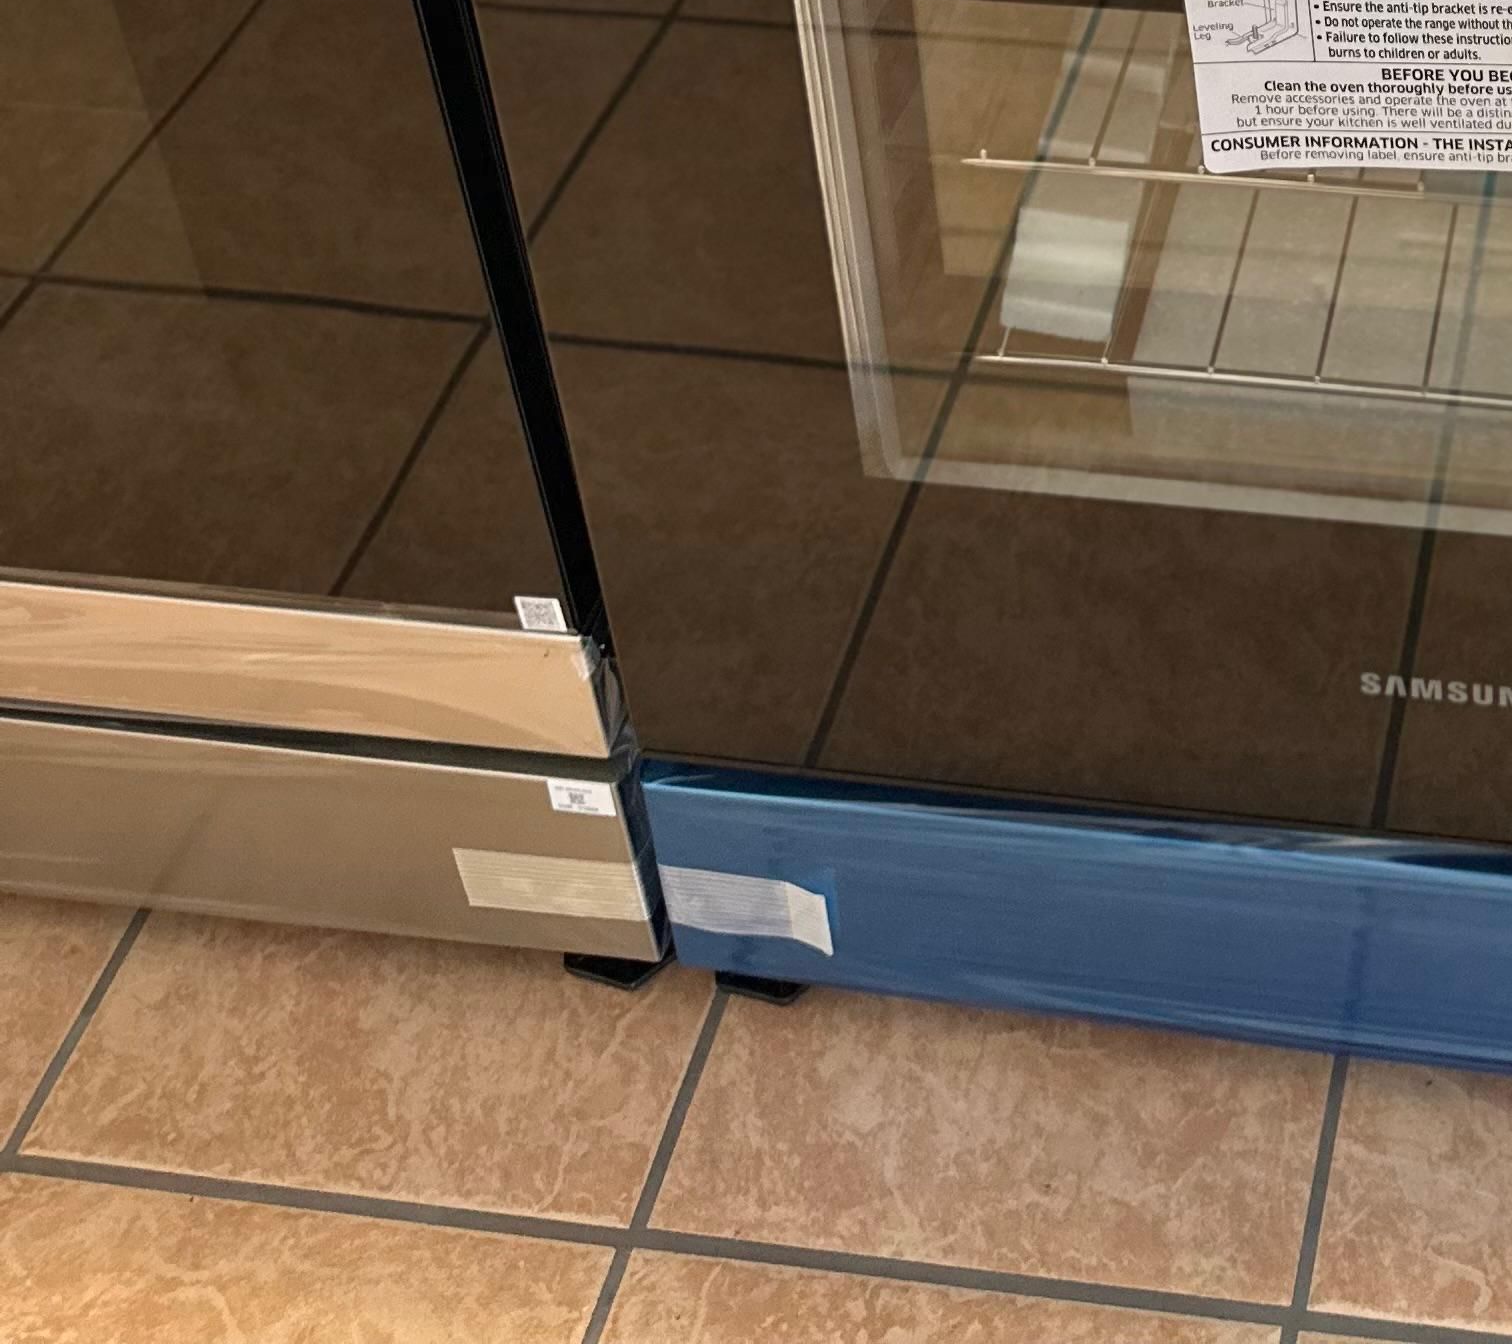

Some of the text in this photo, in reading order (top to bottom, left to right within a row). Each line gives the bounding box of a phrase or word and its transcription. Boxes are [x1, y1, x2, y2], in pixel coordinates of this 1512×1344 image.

[1381, 68, 1444, 80] BEFORE
[1449, 69, 1484, 82] YOU
[1210, 136, 1301, 152] CONSUMER
[1305, 136, 1418, 149] INFORMATION
[1433, 138, 1464, 150] THE
